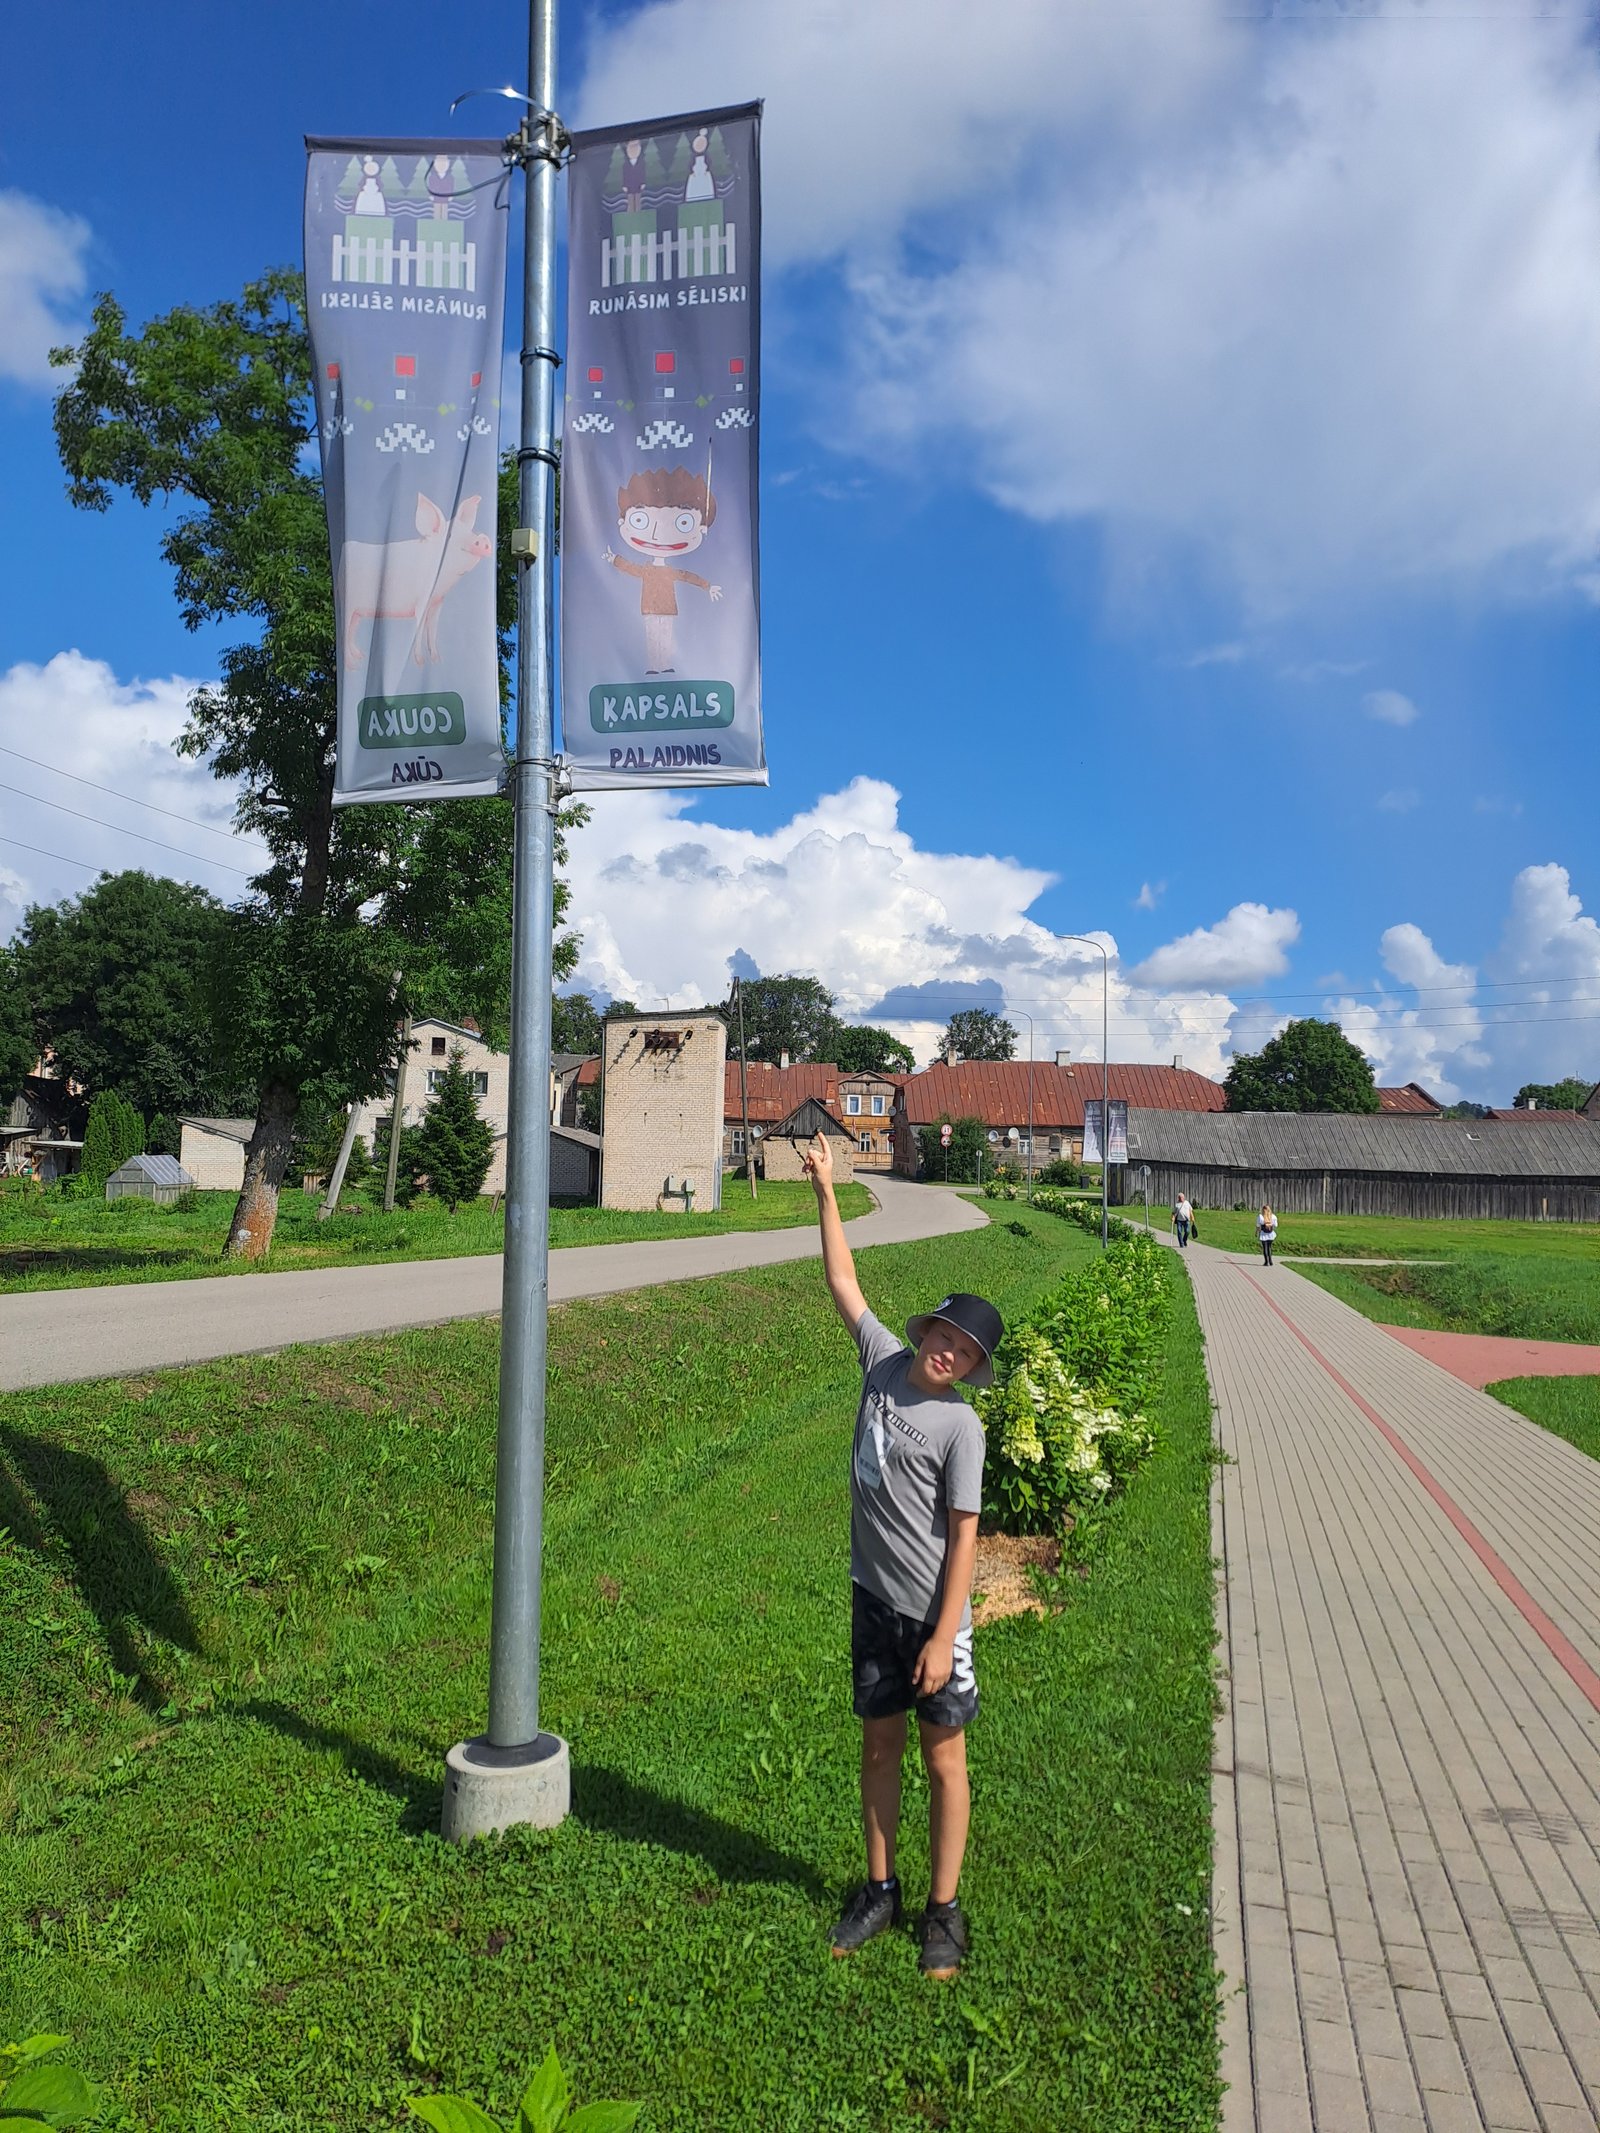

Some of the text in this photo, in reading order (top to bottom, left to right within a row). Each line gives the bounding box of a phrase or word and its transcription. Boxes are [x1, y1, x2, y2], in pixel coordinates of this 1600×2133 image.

[588, 285, 747, 315] RUNĀSIM SĒLISKI
[603, 692, 721, 728] ĶAPSALS
[609, 743, 722, 768] PALAIDNIS
[887, 1413, 928, 1447] ADVENTURE
